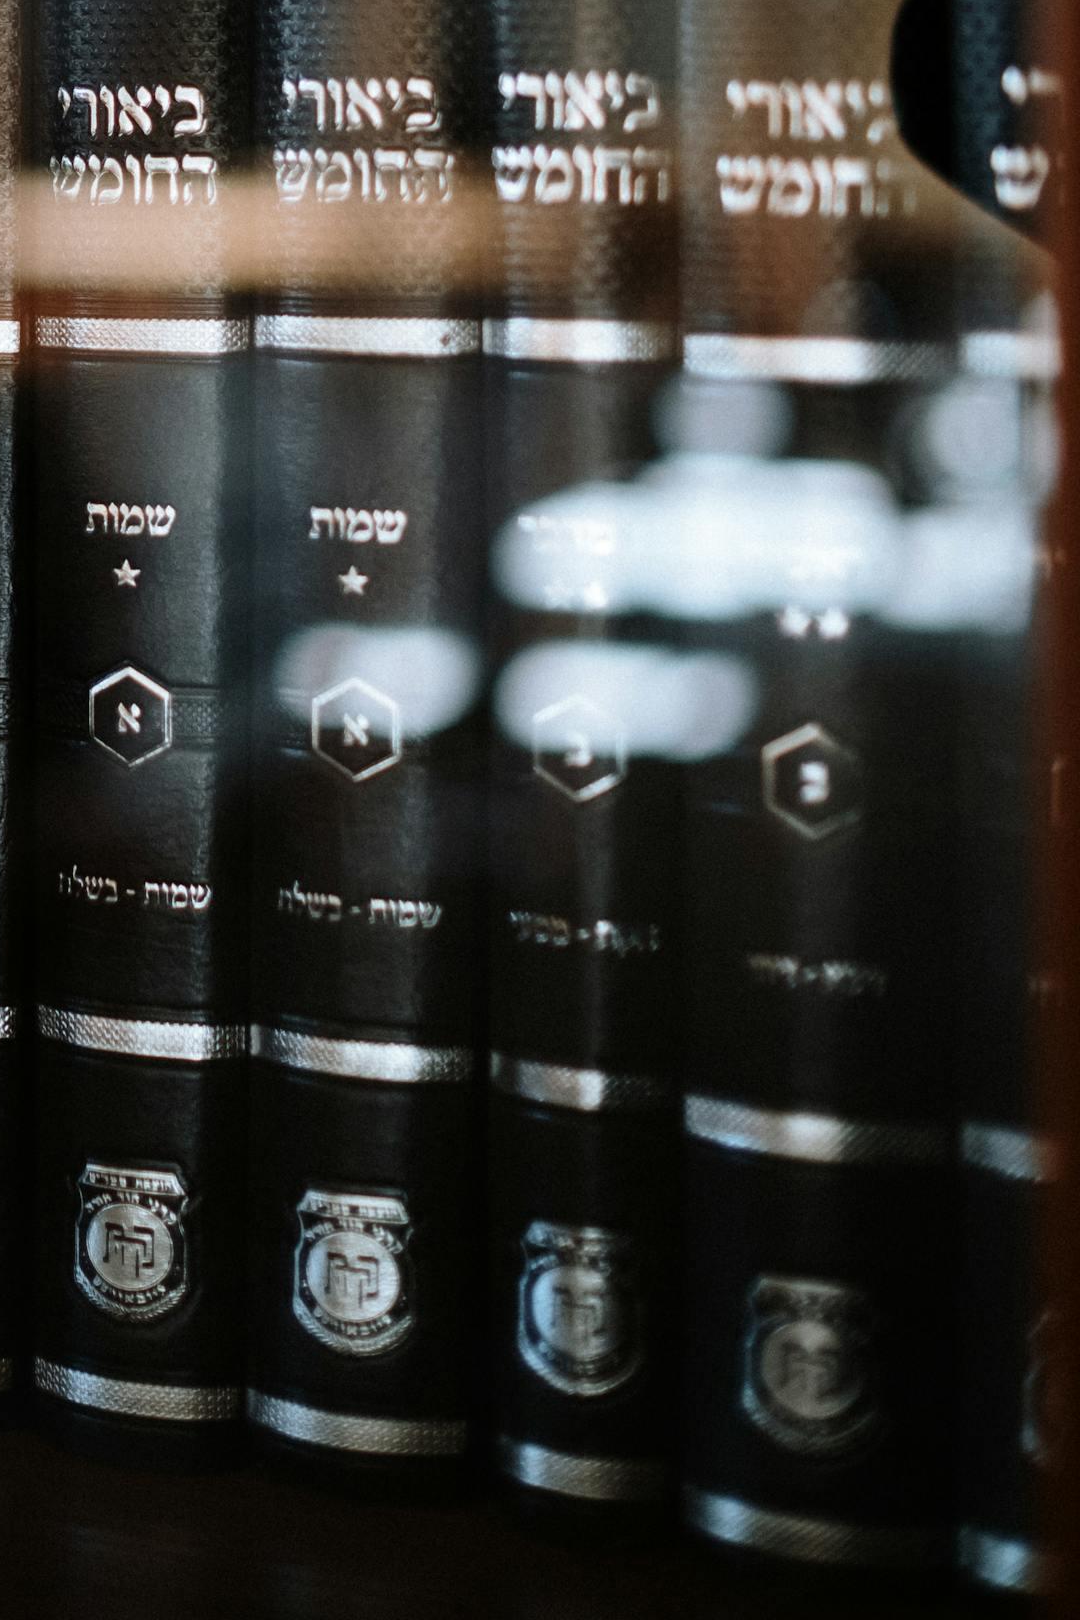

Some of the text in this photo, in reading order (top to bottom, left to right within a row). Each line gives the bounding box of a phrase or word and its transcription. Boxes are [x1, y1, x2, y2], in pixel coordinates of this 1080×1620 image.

[57, 84, 208, 138] ביאורי
[281, 77, 443, 134] ביאורי
[498, 70, 659, 134] ביאורי
[48, 153, 218, 207] החומש
[273, 148, 455, 203] החומש
[491, 143, 669, 206] החומש
[716, 154, 918, 219] החומש
[85, 501, 177, 537] שמות
[308, 506, 408, 544] שמות
[117, 702, 142, 734] א
[342, 713, 369, 747] א
[143, 881, 212, 910] שמות
[368, 897, 442, 928] שמות
